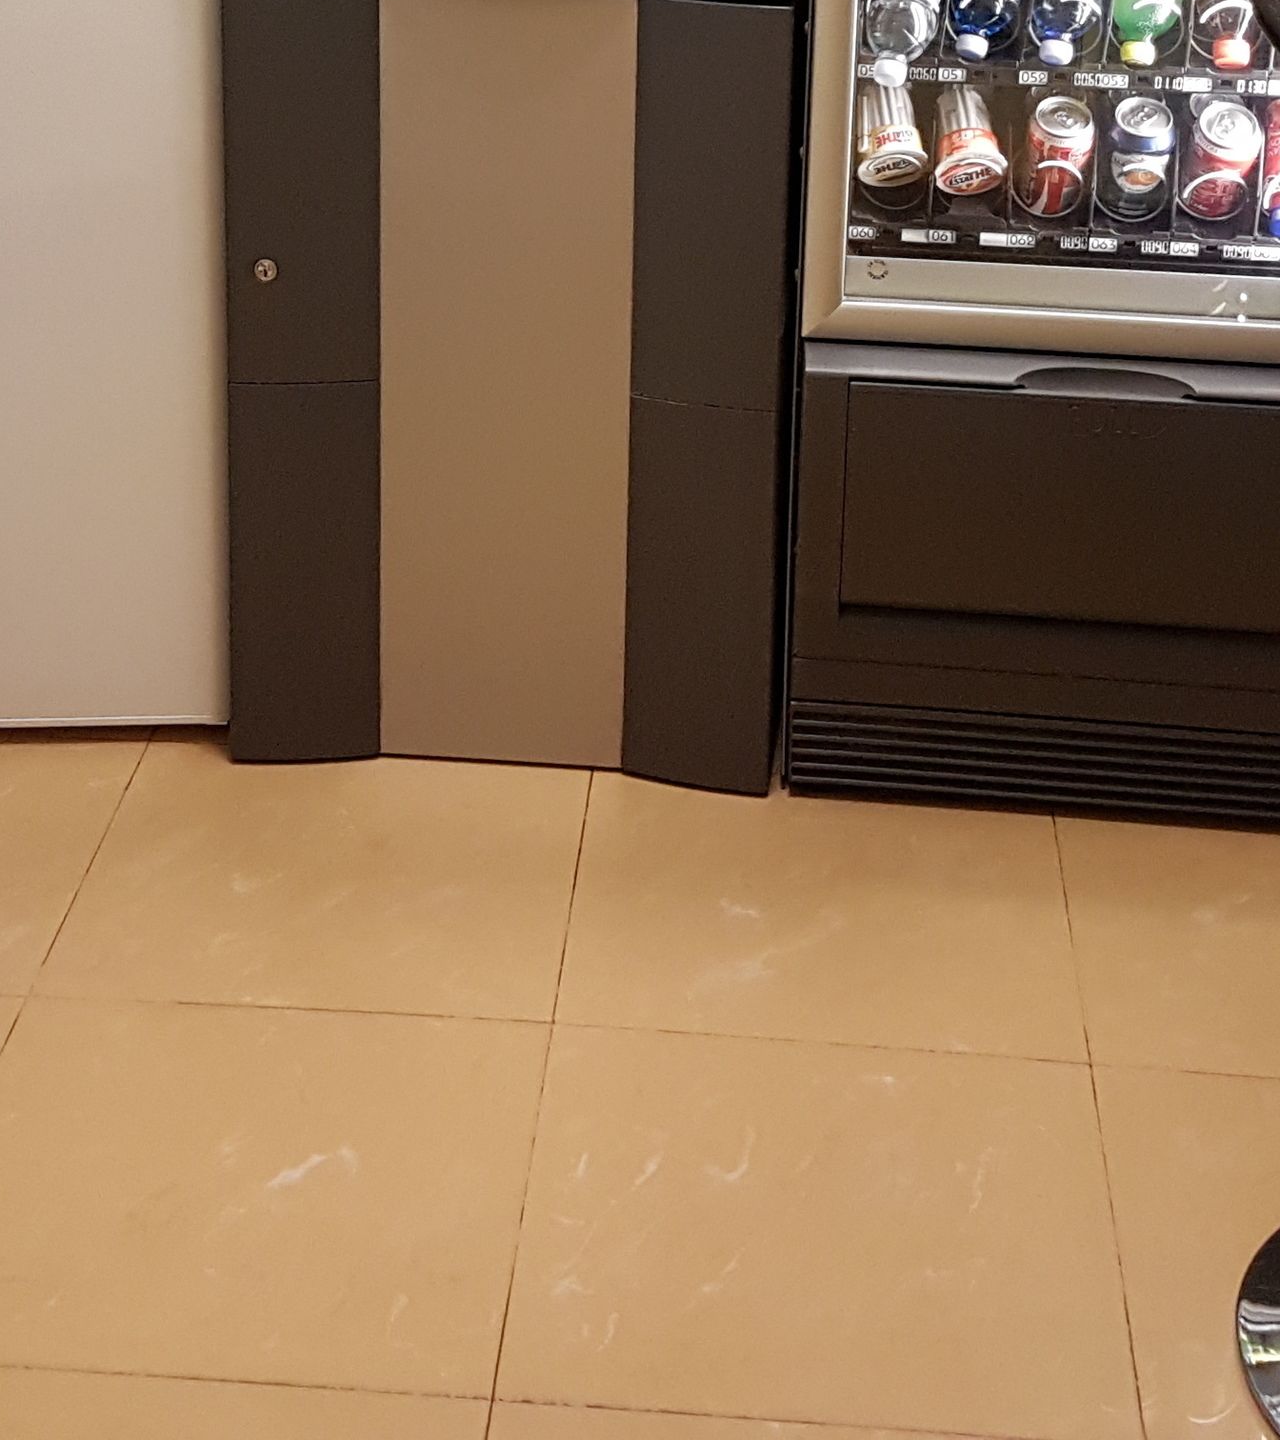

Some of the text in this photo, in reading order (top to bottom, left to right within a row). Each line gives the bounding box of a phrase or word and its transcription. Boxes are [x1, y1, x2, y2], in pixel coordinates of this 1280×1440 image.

[942, 69, 966, 81] 051
[1021, 71, 1047, 83] 052
[1101, 74, 1127, 86] 053
[851, 227, 876, 238] 060
[932, 231, 955, 242] 061
[1009, 234, 1034, 246] 062
[1091, 240, 1116, 250] 063
[1172, 242, 1197, 254] 064
